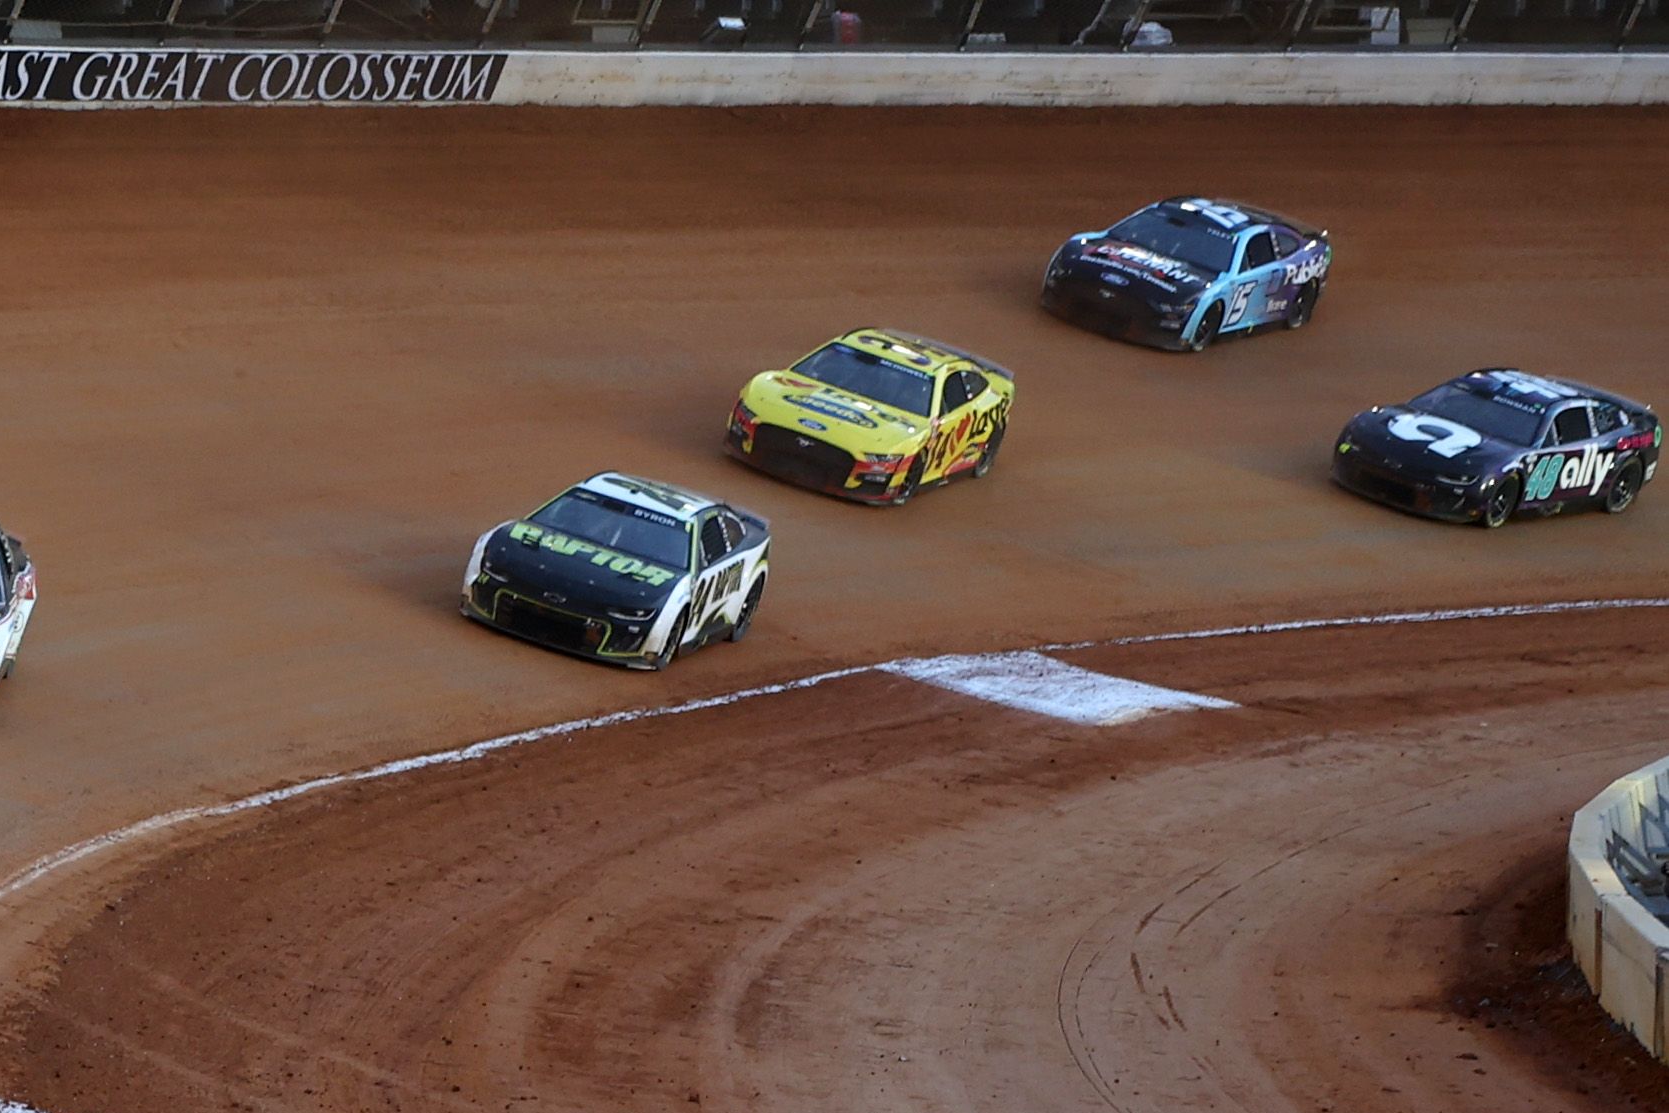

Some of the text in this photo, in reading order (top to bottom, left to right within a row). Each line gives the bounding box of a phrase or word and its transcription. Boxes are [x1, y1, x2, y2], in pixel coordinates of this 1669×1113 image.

[72, 53, 226, 100] GREAT
[228, 54, 498, 101] COLOSSEUM
[1525, 443, 1615, 501] 48 ally
[633, 508, 676, 528] BYRON
